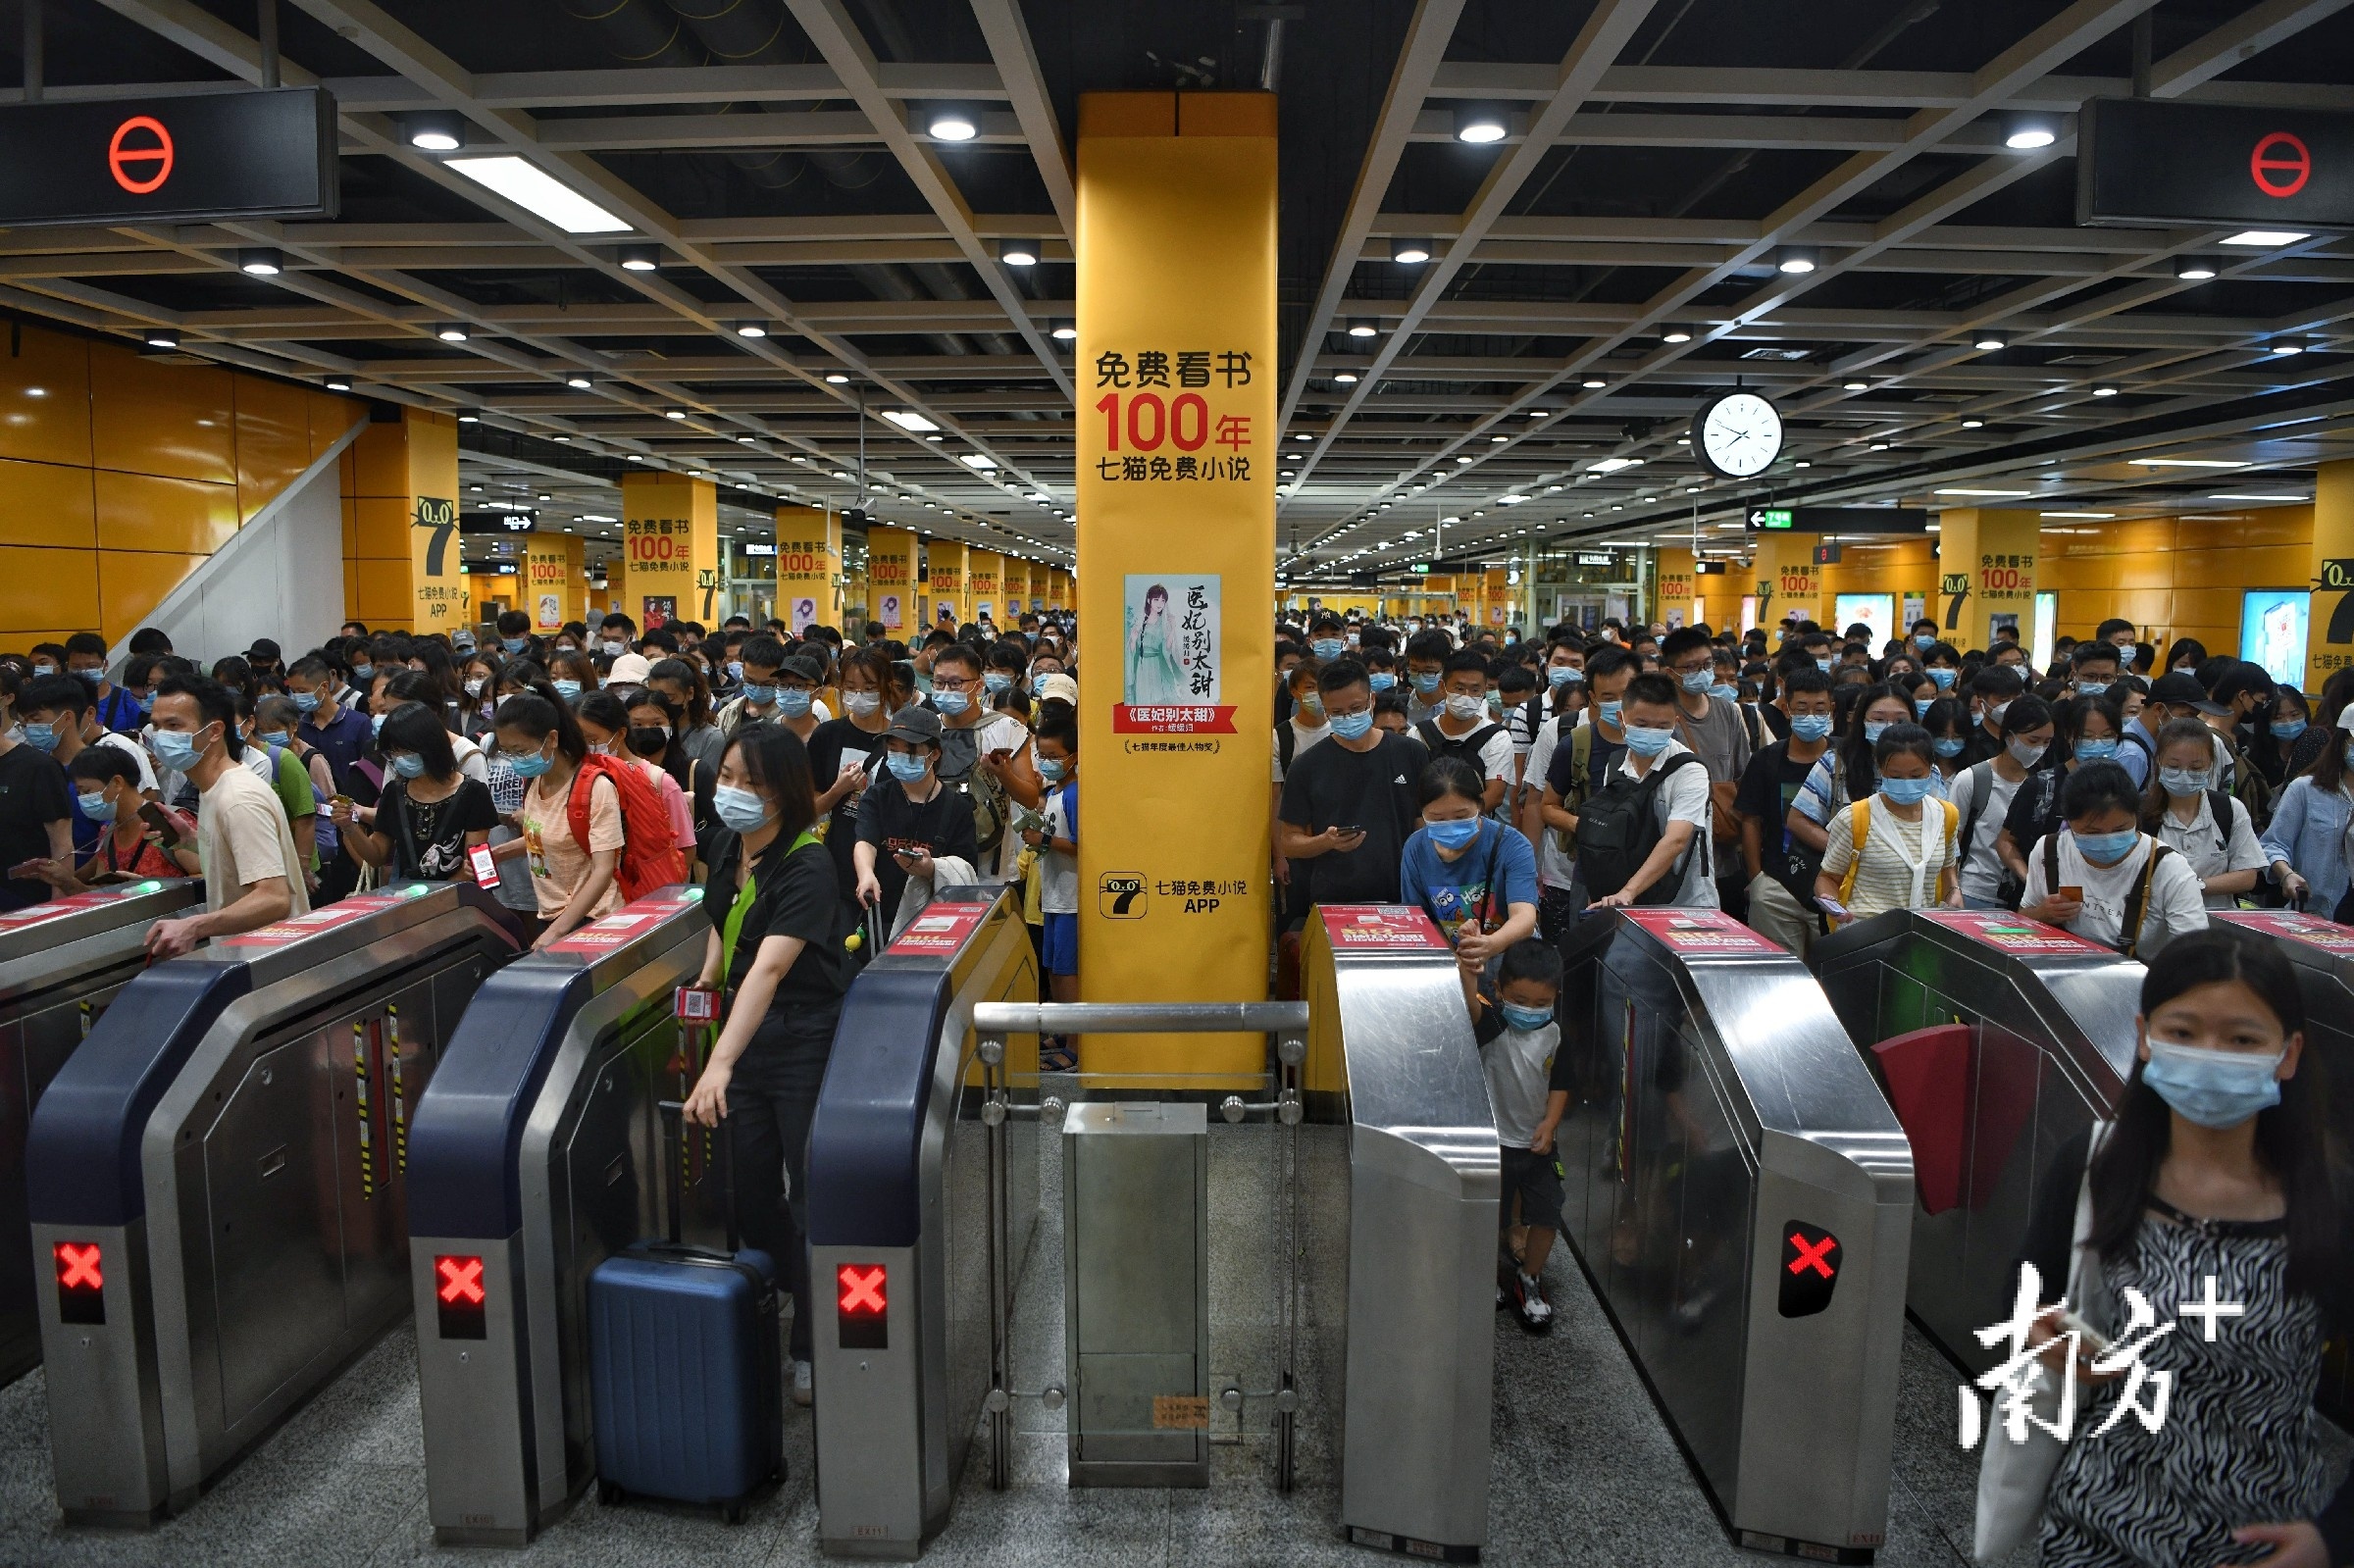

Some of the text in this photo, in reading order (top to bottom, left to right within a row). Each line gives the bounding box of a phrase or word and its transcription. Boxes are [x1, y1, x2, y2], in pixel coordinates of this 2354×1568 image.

[1096, 351, 1253, 388] 免费看书
[1096, 392, 1252, 452] 100年
[1096, 456, 1252, 481] 七猫免费小说
[628, 520, 690, 534] 免费看书
[780, 541, 826, 553] 免费看书
[531, 554, 566, 564] 免费看书
[871, 555, 907, 564] 免费看书
[1981, 554, 2033, 569] 免费看书
[629, 562, 690, 572] 七猫免费小说
[1780, 566, 1819, 577] 免费看书
[418, 586, 458, 600] 七猫免费小说
[1980, 589, 2031, 599] 七猫免费小说
[430, 603, 447, 618] APP
[1181, 584, 1214, 698] 医妃别太甜
[1129, 707, 1215, 723] 《医妃别太甜》
[1132, 742, 1213, 752] 七猫年度最佳人物奖
[1155, 880, 1247, 895] 七猫免费小说
[1184, 898, 1220, 913] APP
